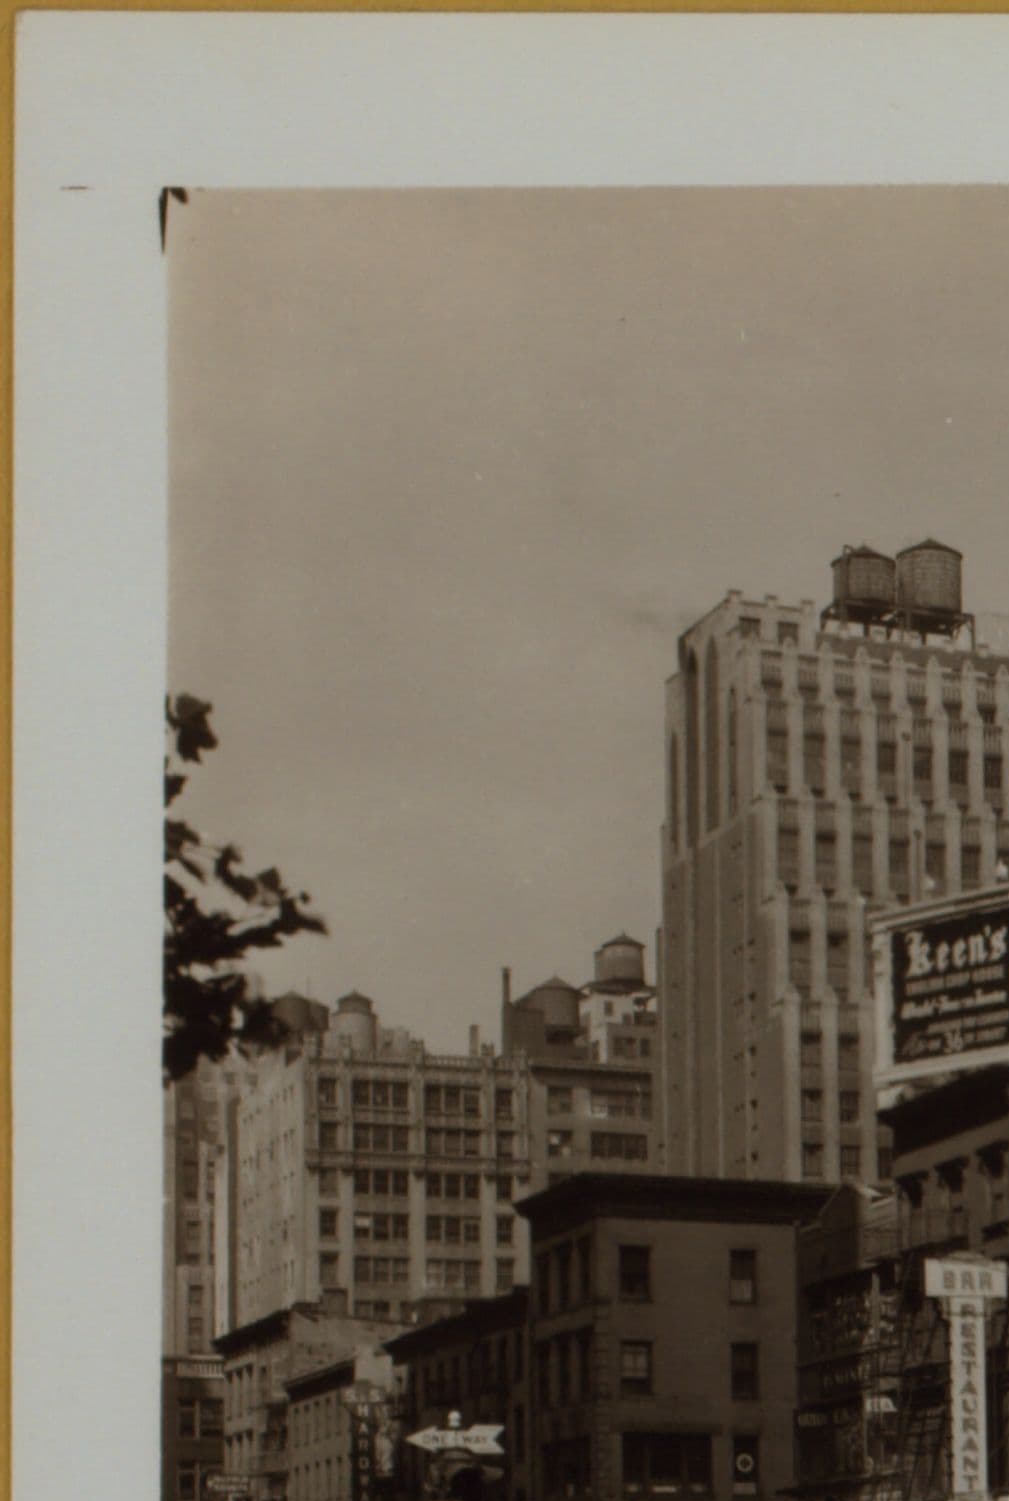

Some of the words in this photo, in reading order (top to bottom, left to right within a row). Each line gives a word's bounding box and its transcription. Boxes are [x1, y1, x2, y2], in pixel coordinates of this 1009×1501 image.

[942, 1270, 993, 1290] BAR
[960, 1303, 979, 1492] RESTAURANT
[423, 1434, 448, 1446] ONE
[462, 1434, 489, 1446] WAY
